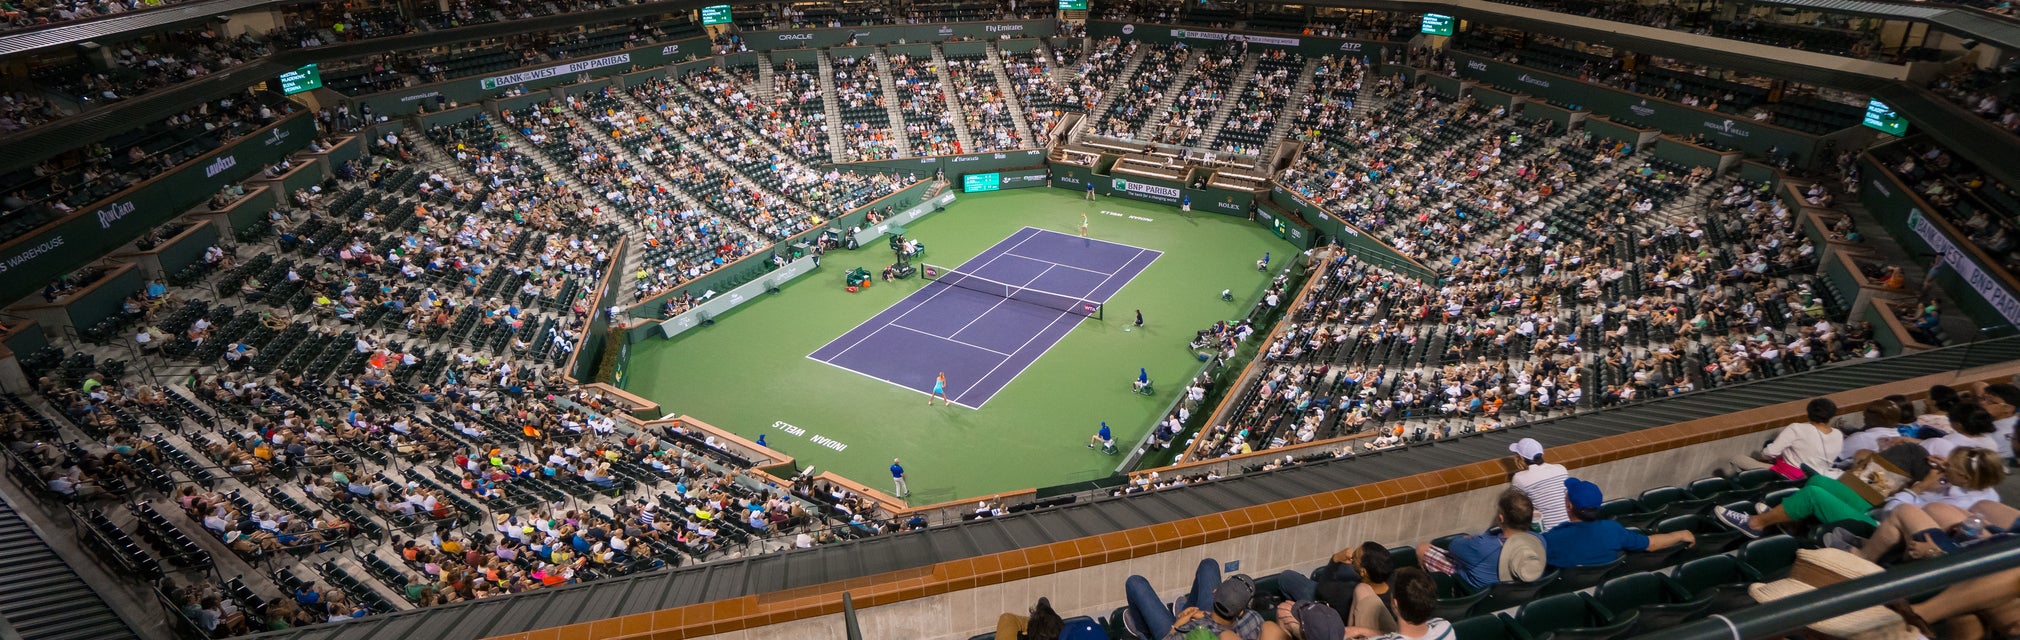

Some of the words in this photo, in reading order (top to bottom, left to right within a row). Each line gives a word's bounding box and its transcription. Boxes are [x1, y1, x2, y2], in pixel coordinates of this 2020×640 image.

[985, 25, 997, 33] Fly
[997, 24, 1023, 32] Emirates
[778, 33, 813, 41] ORACLE
[663, 45, 679, 55] ATP
[1341, 42, 1362, 50] ATP
[496, 74, 523, 86] BANK
[531, 67, 557, 80] WEST
[569, 62, 589, 72] BNP
[590, 54, 629, 68] PARIBAS
[1467, 60, 1488, 72] Hertz
[205, 155, 237, 178] LAVAZZA
[1061, 176, 1080, 184] ROLEX
[1127, 182, 1144, 190] BNP
[1145, 185, 1177, 197] PARIBAS
[1218, 202, 1240, 210] ROLEX
[7, 236, 64, 268] WAREHOUSE
[1970, 268, 1993, 295] BNP
[772, 420, 806, 437] WELLS
[810, 434, 848, 452] INDIAN
